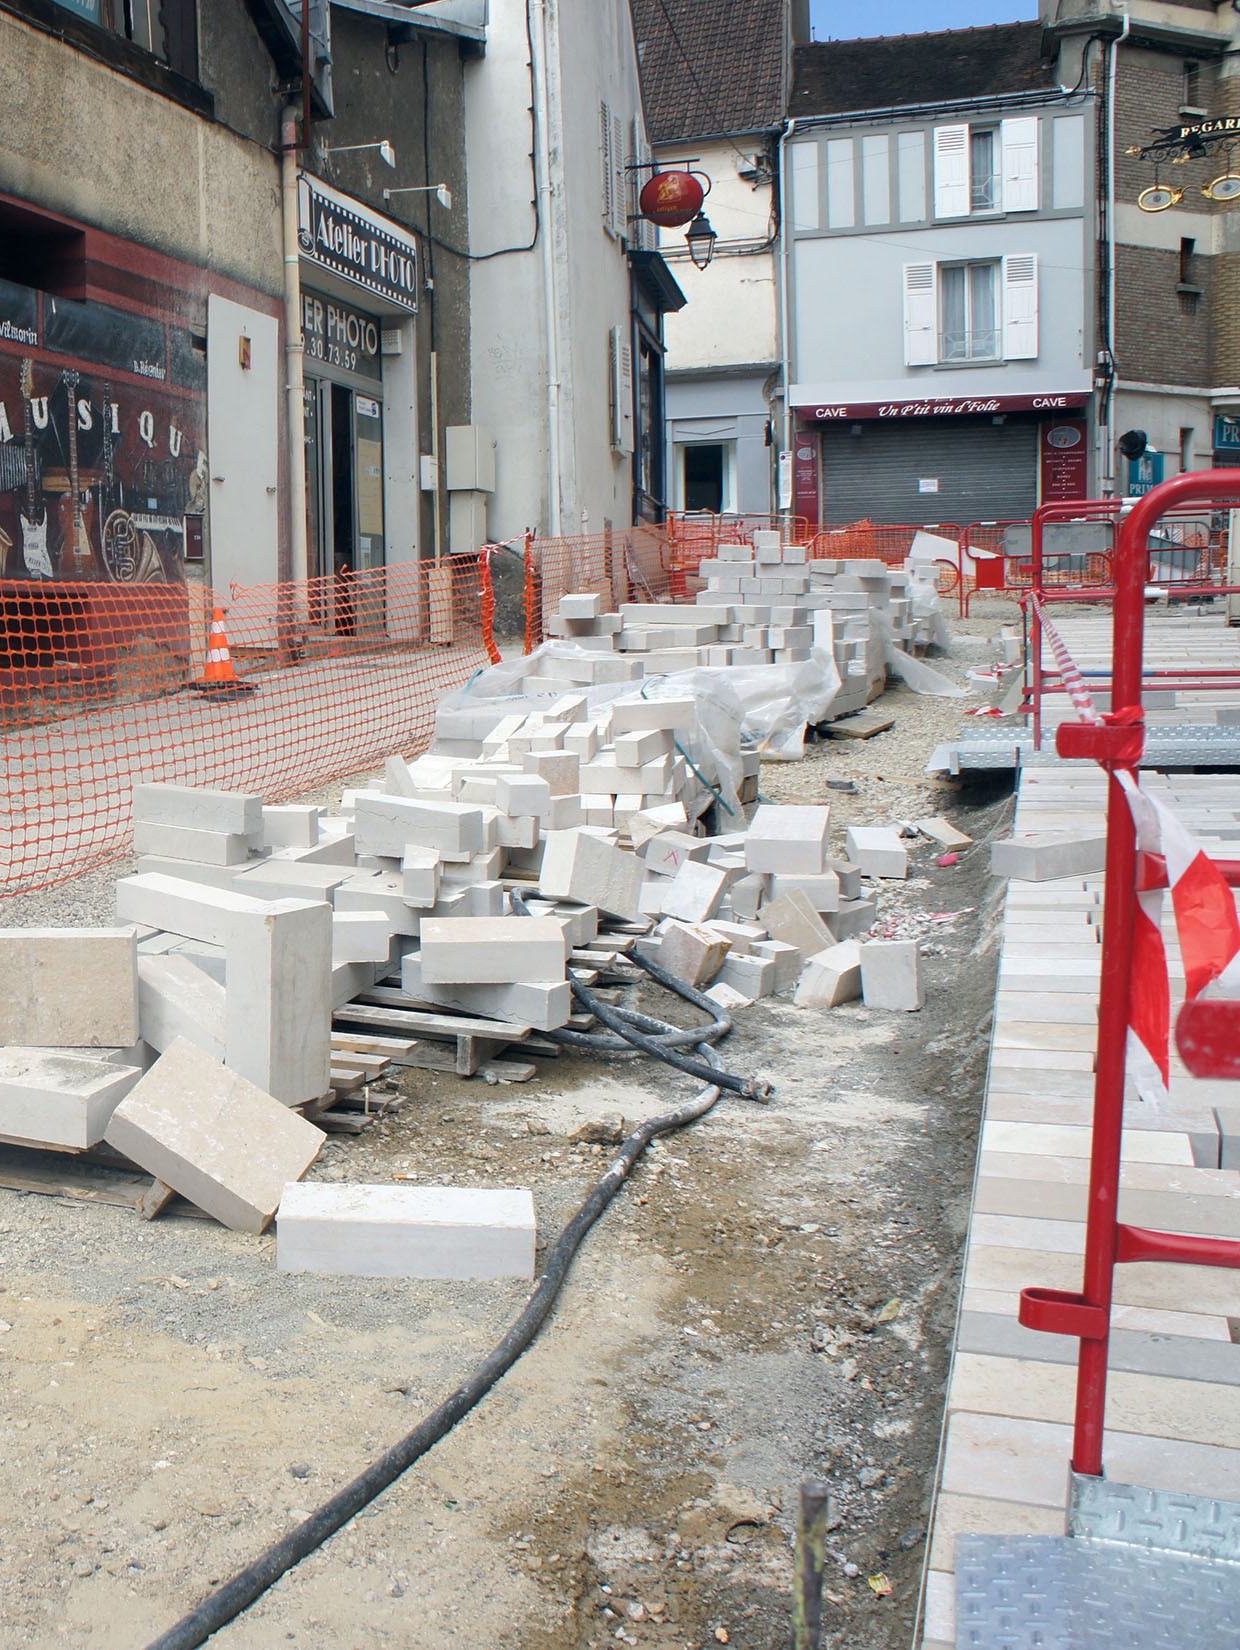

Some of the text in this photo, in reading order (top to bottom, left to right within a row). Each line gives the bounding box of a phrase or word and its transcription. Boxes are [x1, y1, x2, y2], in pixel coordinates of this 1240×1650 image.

[316, 210, 415, 292] Atelier PHOTO
[327, 304, 378, 355] PHOTO
[878, 399, 1000, 417] Un P'tit vin d'Folie
[1032, 396, 1066, 408] CAVE
[815, 407, 847, 418] CAVE
